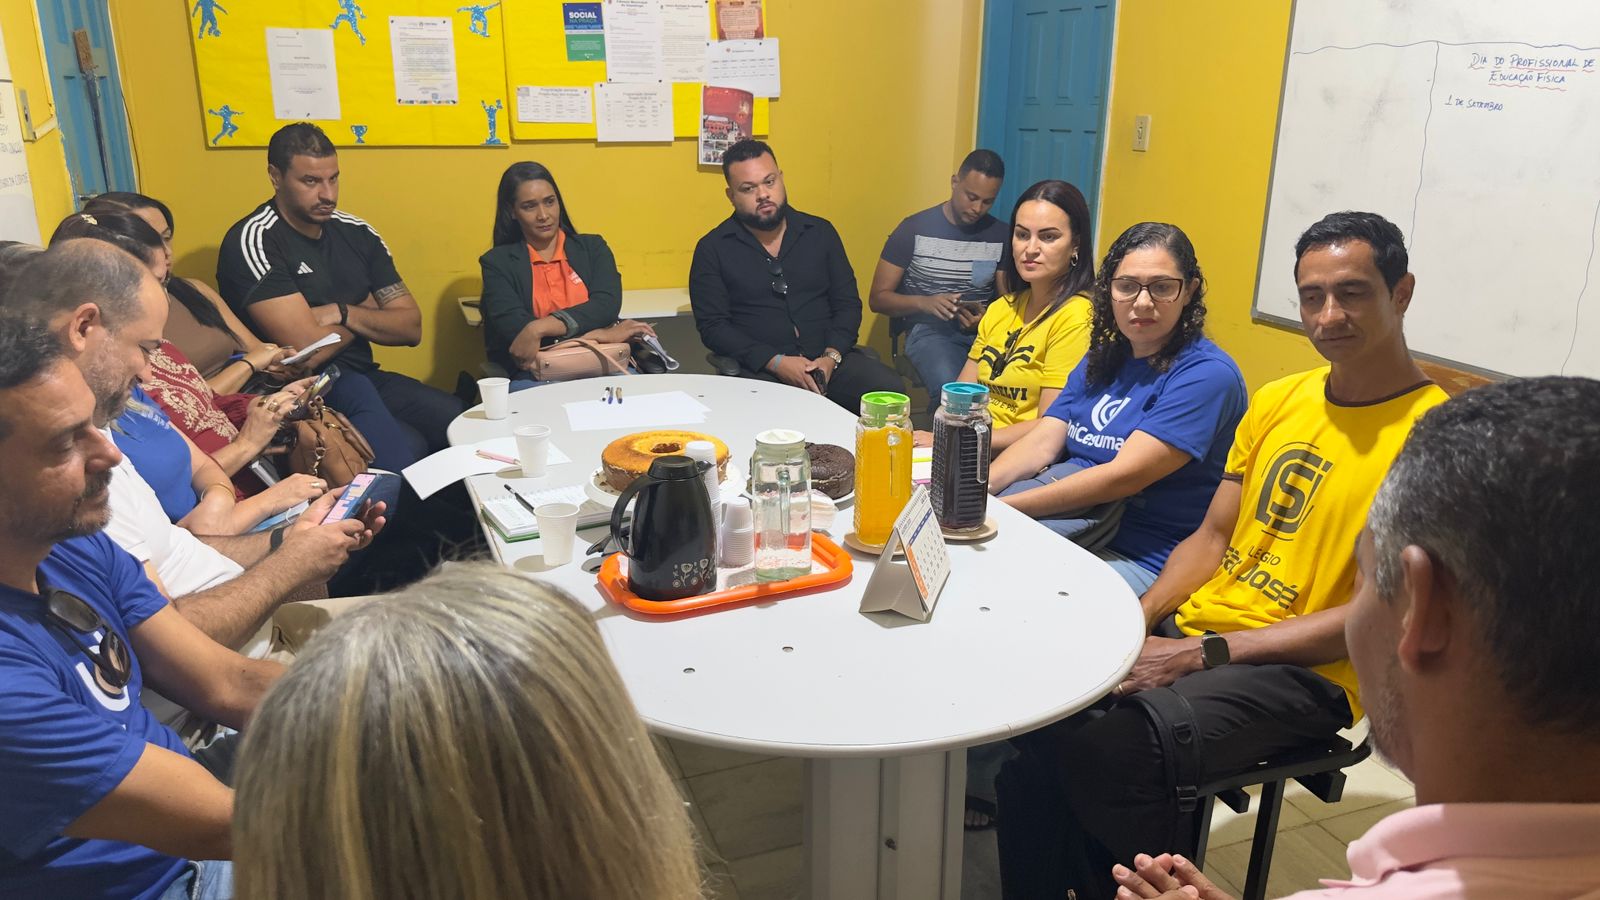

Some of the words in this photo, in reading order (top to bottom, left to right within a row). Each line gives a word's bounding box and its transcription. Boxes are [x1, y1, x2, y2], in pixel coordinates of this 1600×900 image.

[568, 11, 598, 19] SOCIAL
[1494, 56, 1505, 65] DO
[1510, 54, 1579, 68] PROFISSIONAL
[1583, 58, 1595, 67] DE
[1489, 70, 1533, 84] EDUCAÇÃO
[1536, 71, 1565, 83] FÍSICA
[1455, 98, 1463, 106] DE
[1467, 98, 1504, 111] SETEMBRO
[1067, 419, 1125, 451] niCesuma
